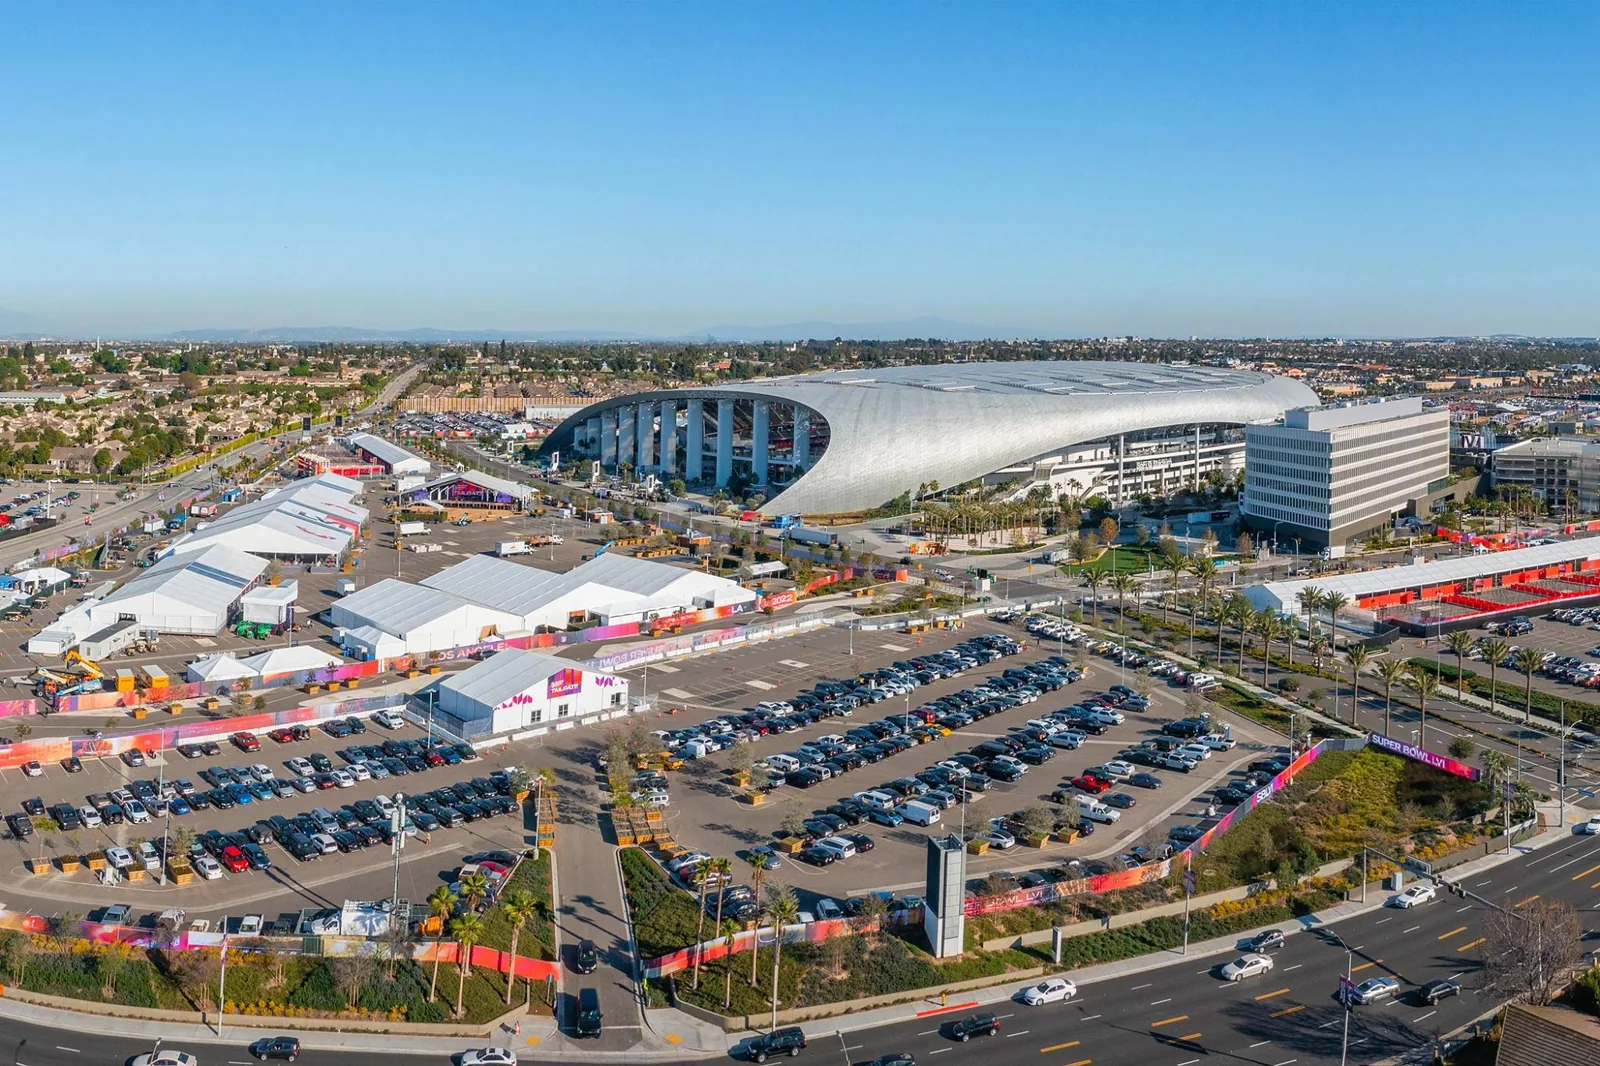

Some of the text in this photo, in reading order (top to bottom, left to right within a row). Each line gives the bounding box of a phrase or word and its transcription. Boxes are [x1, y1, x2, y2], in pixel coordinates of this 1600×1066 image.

[1371, 734, 1445, 768] SUPER BOWL LVI
[1026, 891, 1043, 901] LVI
